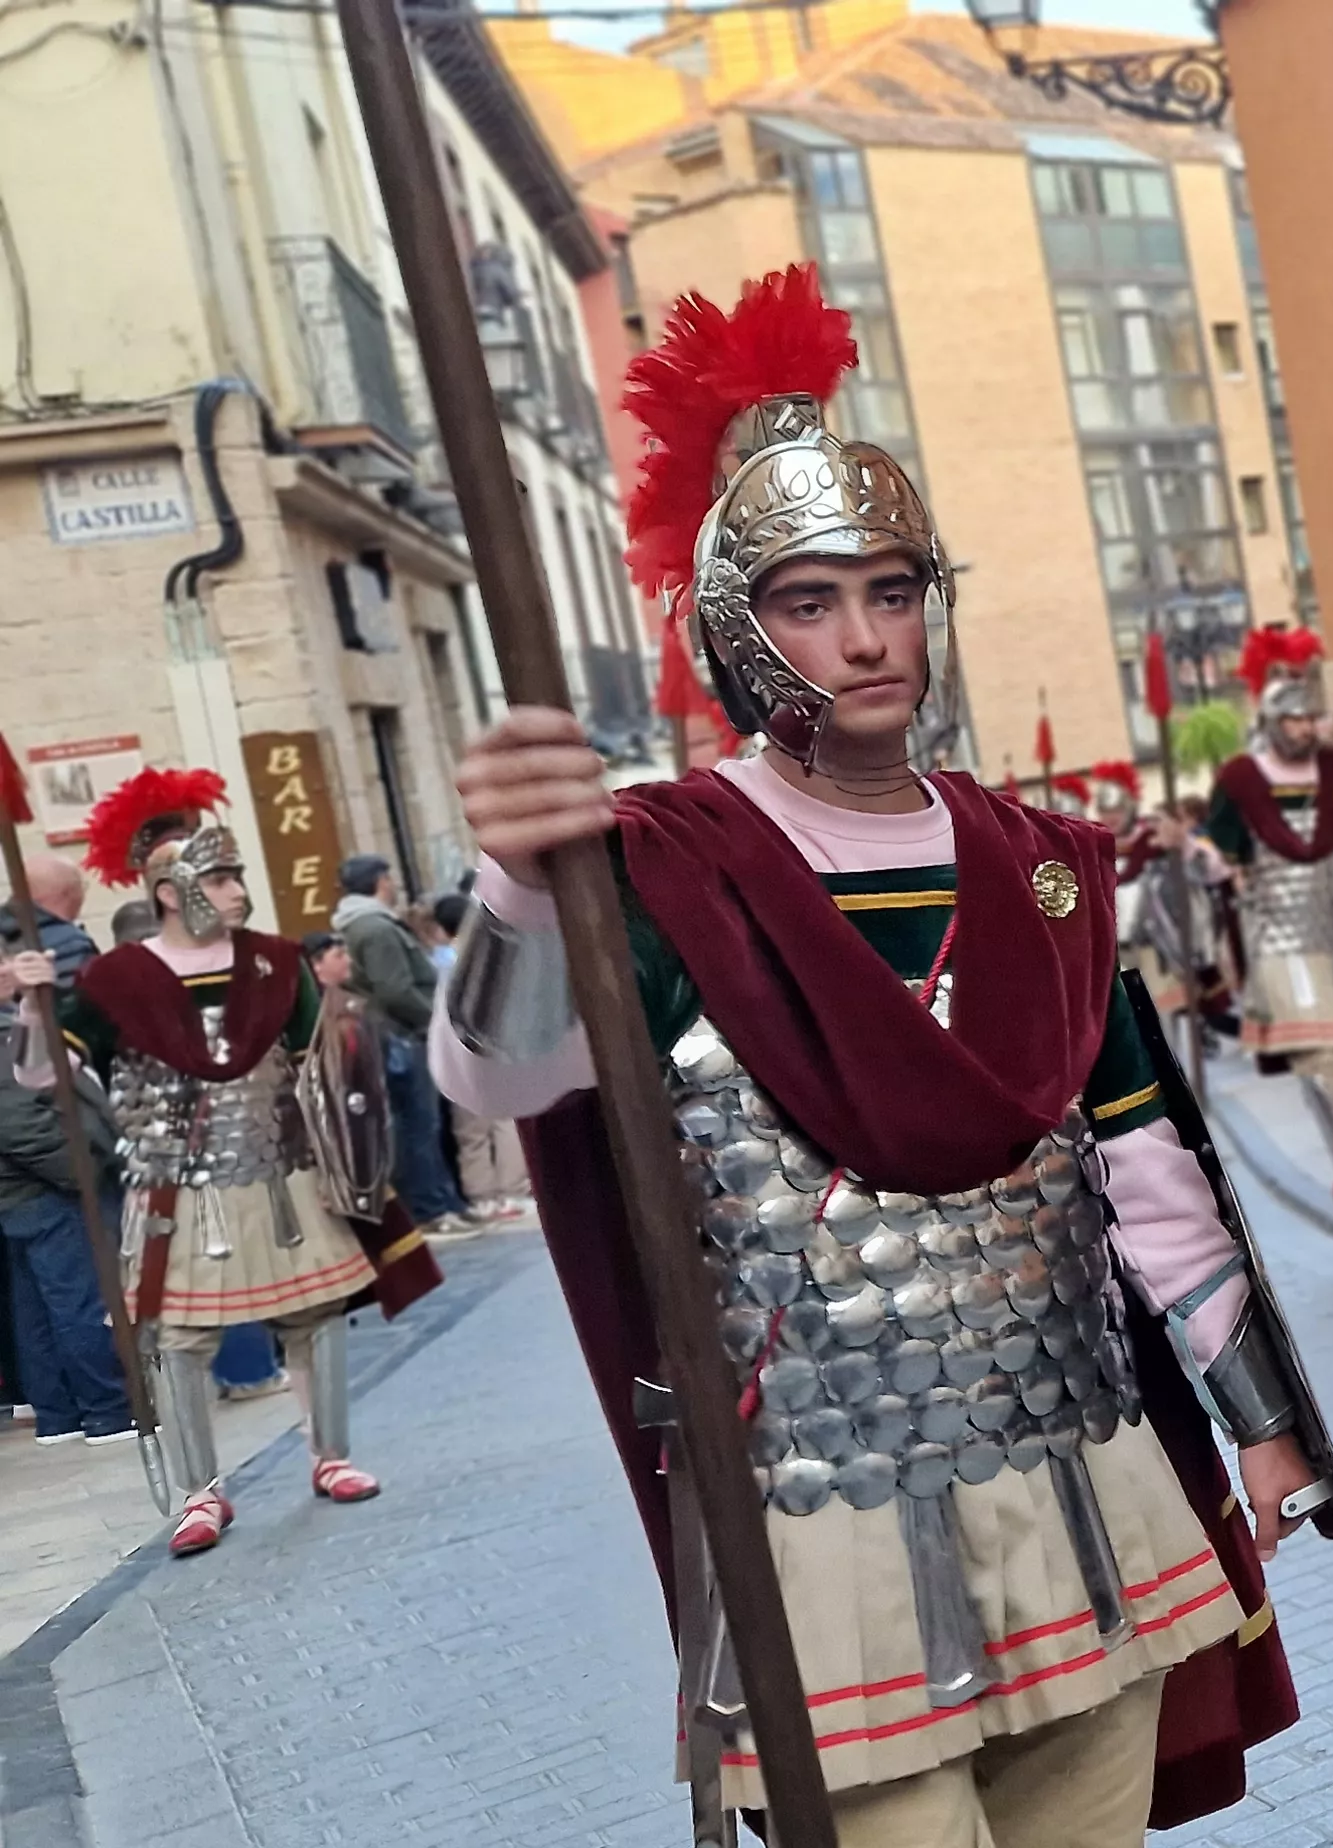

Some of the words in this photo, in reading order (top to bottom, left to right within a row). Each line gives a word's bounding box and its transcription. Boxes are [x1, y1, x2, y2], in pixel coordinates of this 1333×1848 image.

[92, 466, 160, 490] CALLE
[61, 499, 181, 533] CASTILLA
[266, 744, 313, 835] BAR
[291, 855, 328, 915] EL
